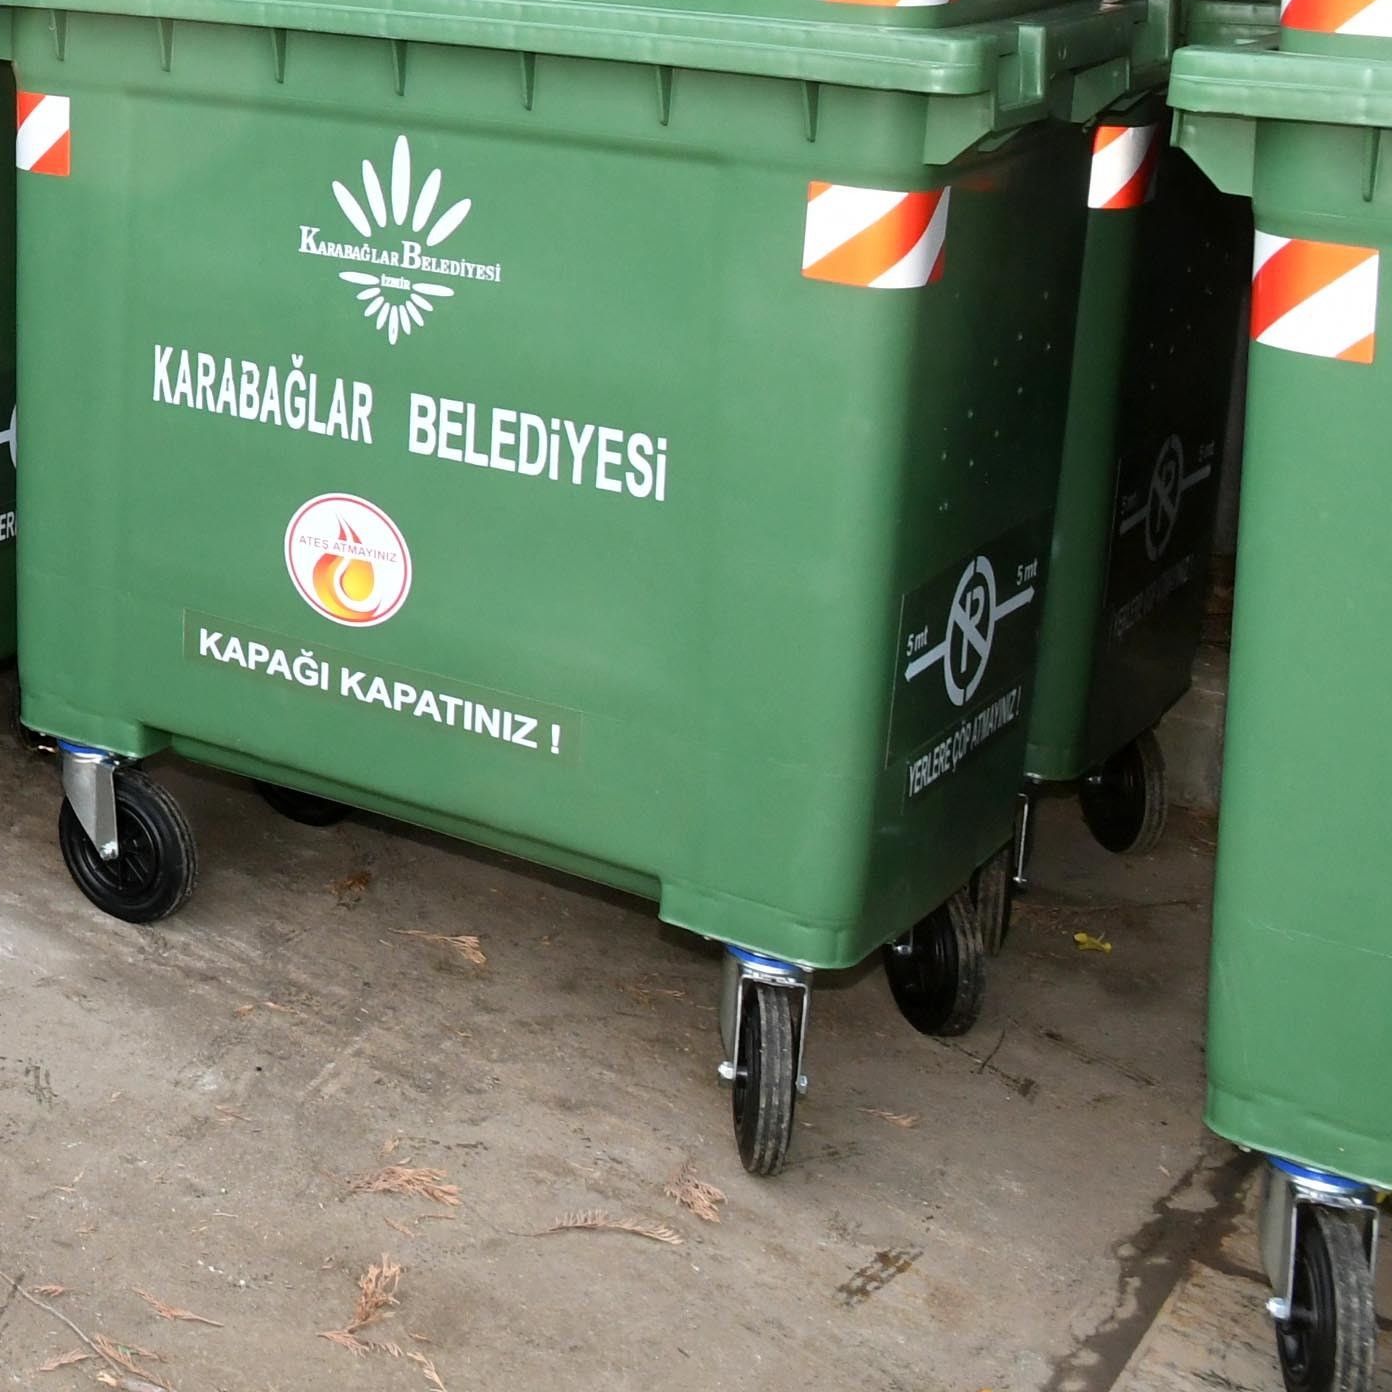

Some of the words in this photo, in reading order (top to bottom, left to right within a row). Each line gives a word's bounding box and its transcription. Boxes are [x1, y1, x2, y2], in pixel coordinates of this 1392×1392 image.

[152, 344, 373, 445] KARABAĞLAR
[333, 541, 398, 563] ATMAYINIZ
[1016, 563, 1024, 587] 5
[1024, 557, 1038, 582] mt
[906, 632, 915, 657] 5
[915, 625, 929, 653] mt
[199, 628, 329, 691] KAPAĞI
[340, 667, 538, 749] KAPATINIZ
[908, 737, 953, 798] YERLERE
